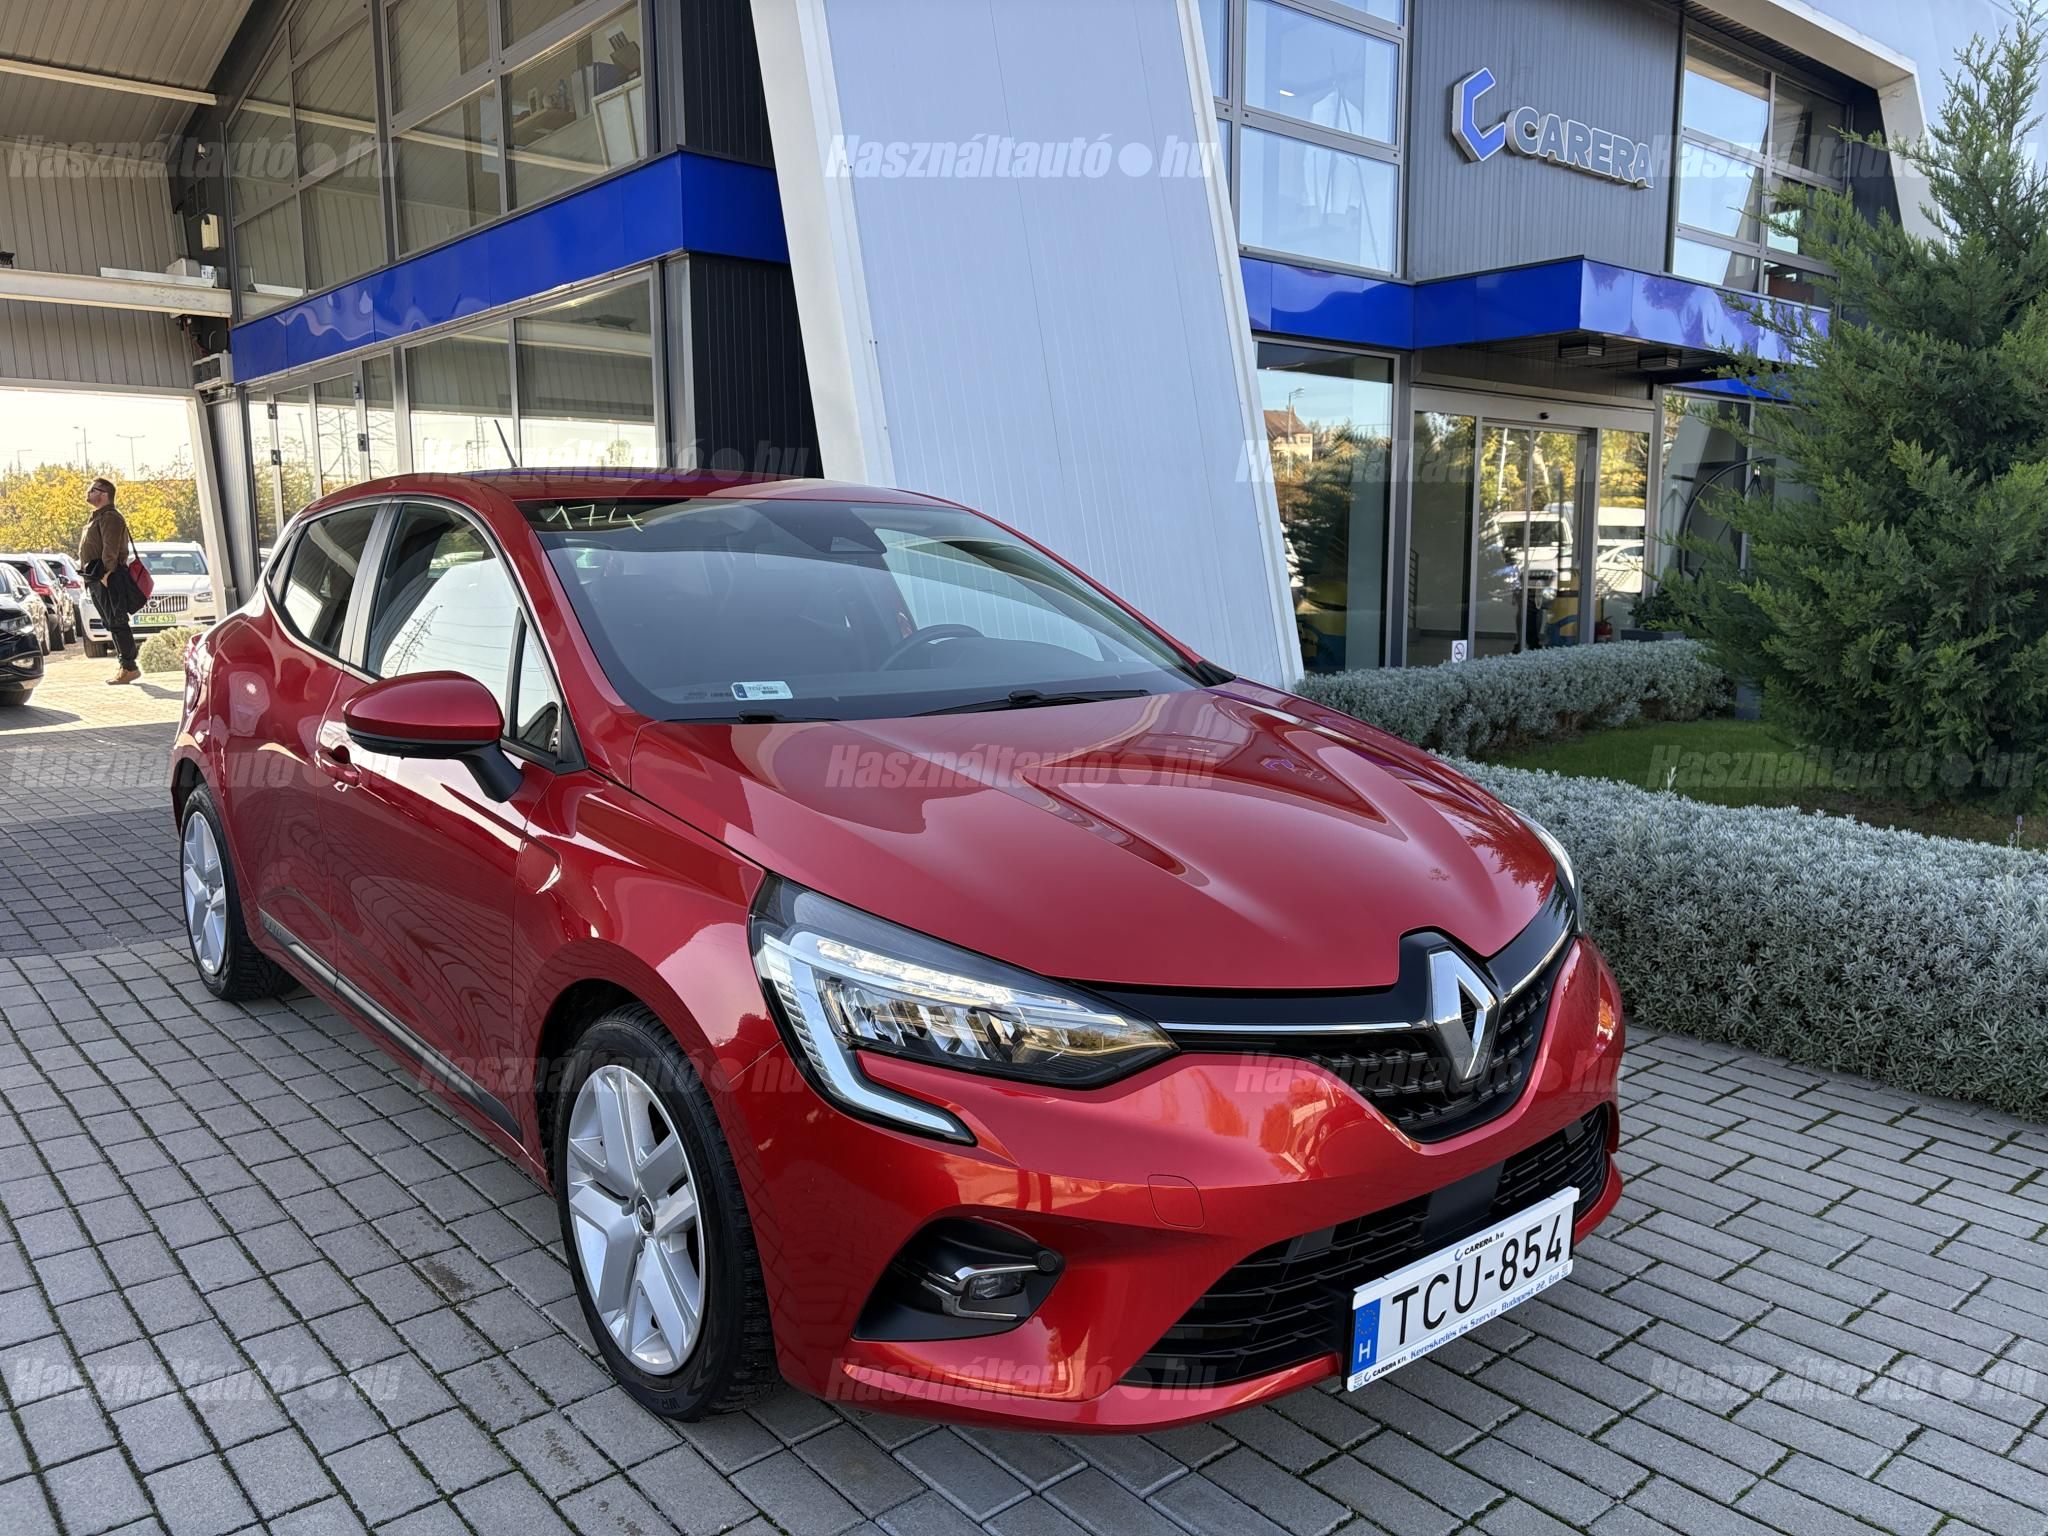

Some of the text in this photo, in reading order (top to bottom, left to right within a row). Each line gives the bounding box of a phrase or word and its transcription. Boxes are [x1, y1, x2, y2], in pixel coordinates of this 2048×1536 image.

[1510, 106, 1654, 188] CARERA
[547, 504, 643, 532] 174
[1392, 1214, 1562, 1346] TCU-854
[1358, 1340, 1371, 1363] H
